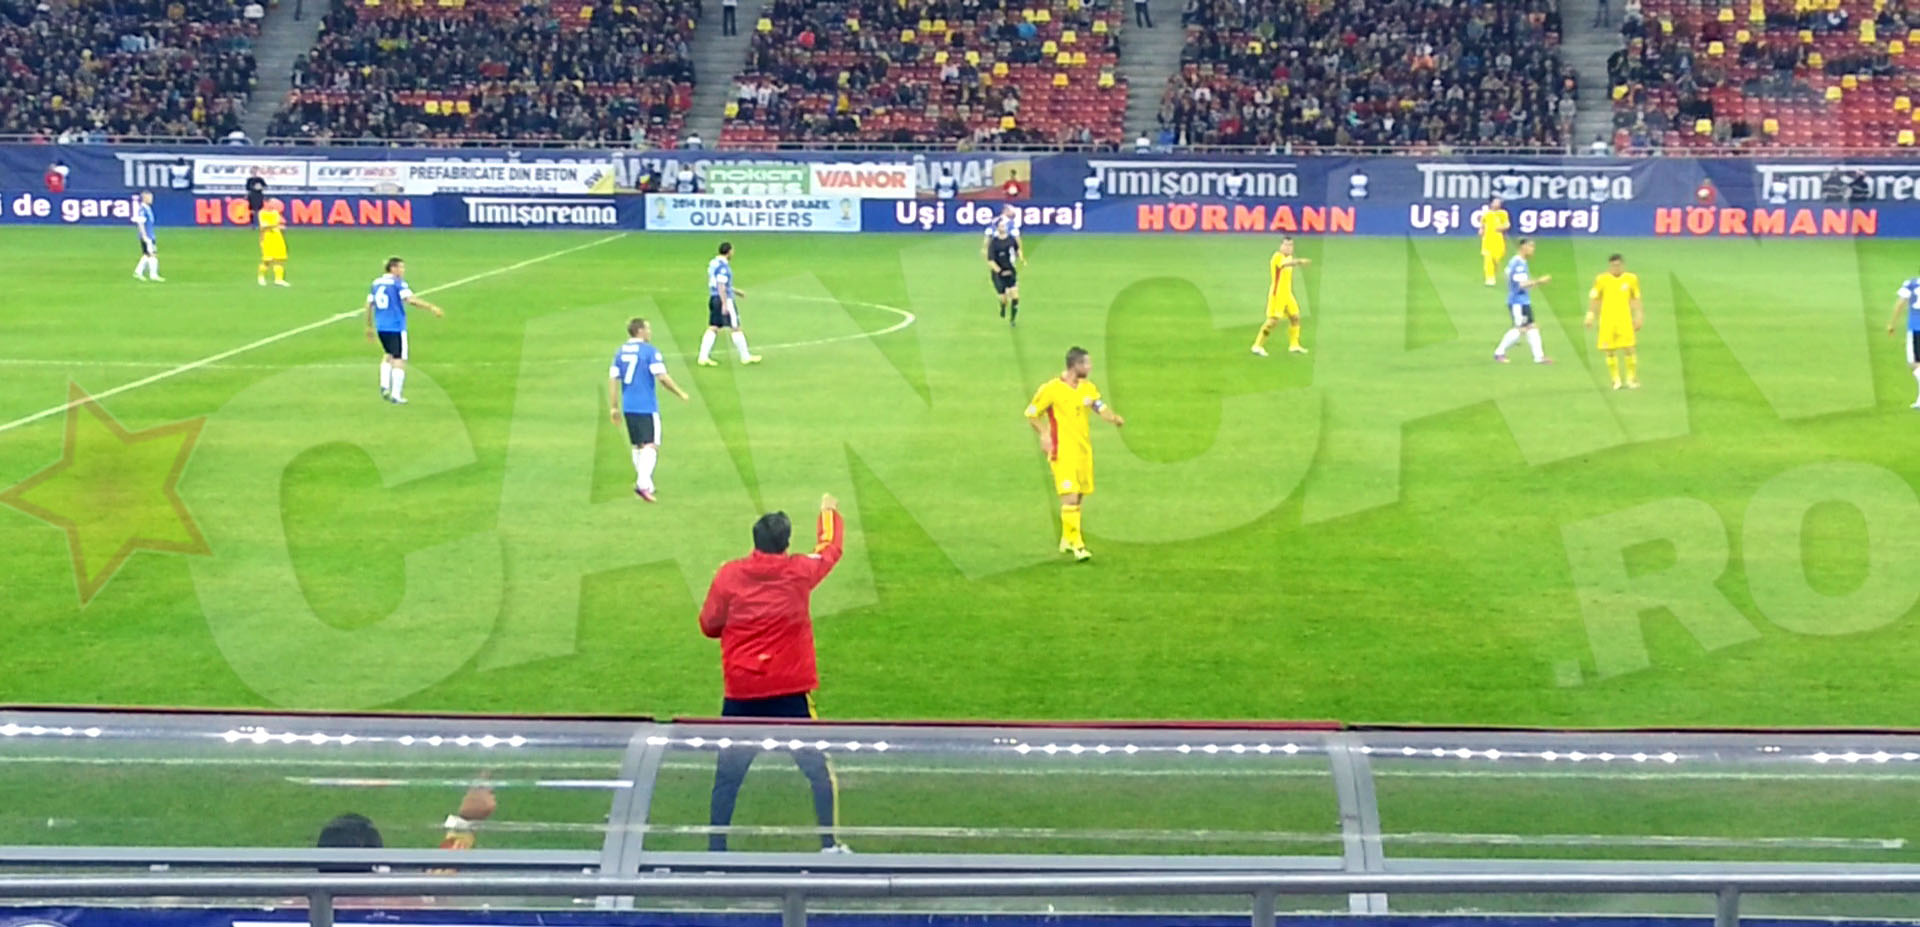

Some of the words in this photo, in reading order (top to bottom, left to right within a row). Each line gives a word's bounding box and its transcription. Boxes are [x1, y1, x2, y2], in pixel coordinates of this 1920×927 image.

[410, 166, 505, 180] PREFABRICATE
[509, 167, 531, 181] DIN
[535, 168, 578, 182] BETON
[816, 170, 907, 188] VIANOR
[13, 193, 51, 217] de
[700, 199, 722, 209] FIFA
[725, 199, 762, 209] WORLD
[765, 199, 788, 209] CUP
[956, 201, 994, 225] de
[690, 211, 813, 227] QUALIFIERS
[1138, 202, 1356, 232] HÖRMANN
[1519, 205, 1600, 233] garaj
[1655, 206, 1877, 235] HÖRMANN
[375, 285, 389, 310] 6
[621, 353, 639, 384] 7
